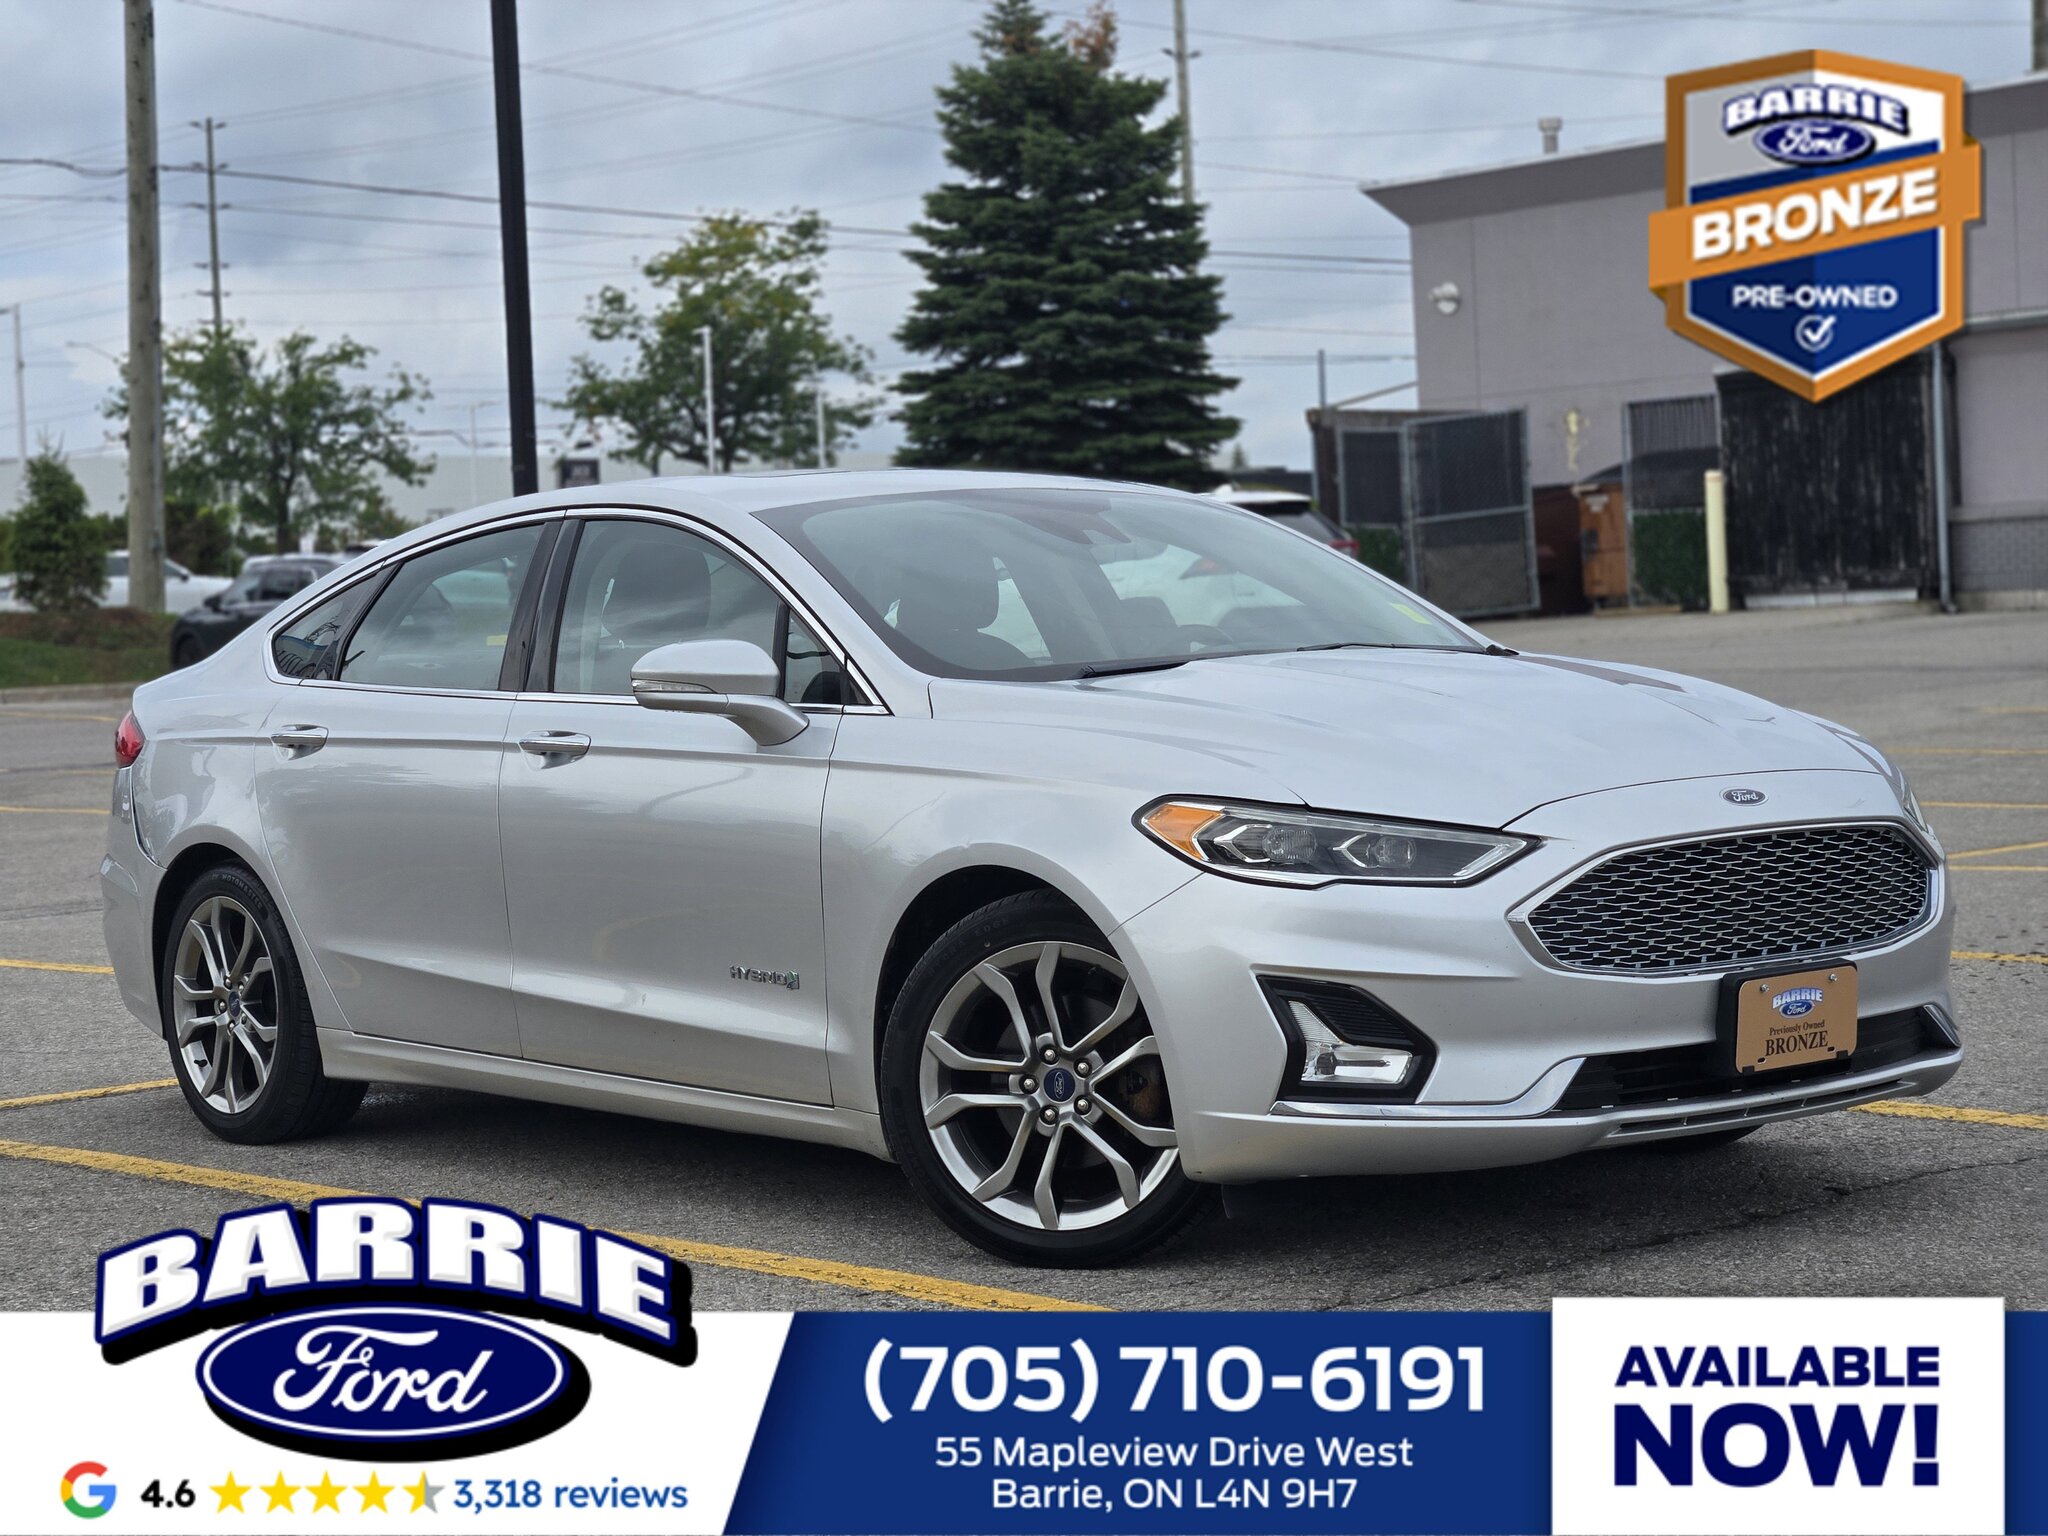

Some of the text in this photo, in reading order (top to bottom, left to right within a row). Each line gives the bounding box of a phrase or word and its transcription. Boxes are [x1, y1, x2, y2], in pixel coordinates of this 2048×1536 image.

[1731, 790, 1759, 802] Ford
[729, 965, 787, 986] HYBRID
[1772, 988, 1823, 1009] BARRIE
[1787, 1002, 1807, 1015] Ford
[1769, 1019, 1825, 1036] Previously Owned
[1765, 1030, 1829, 1057] BRONZE
